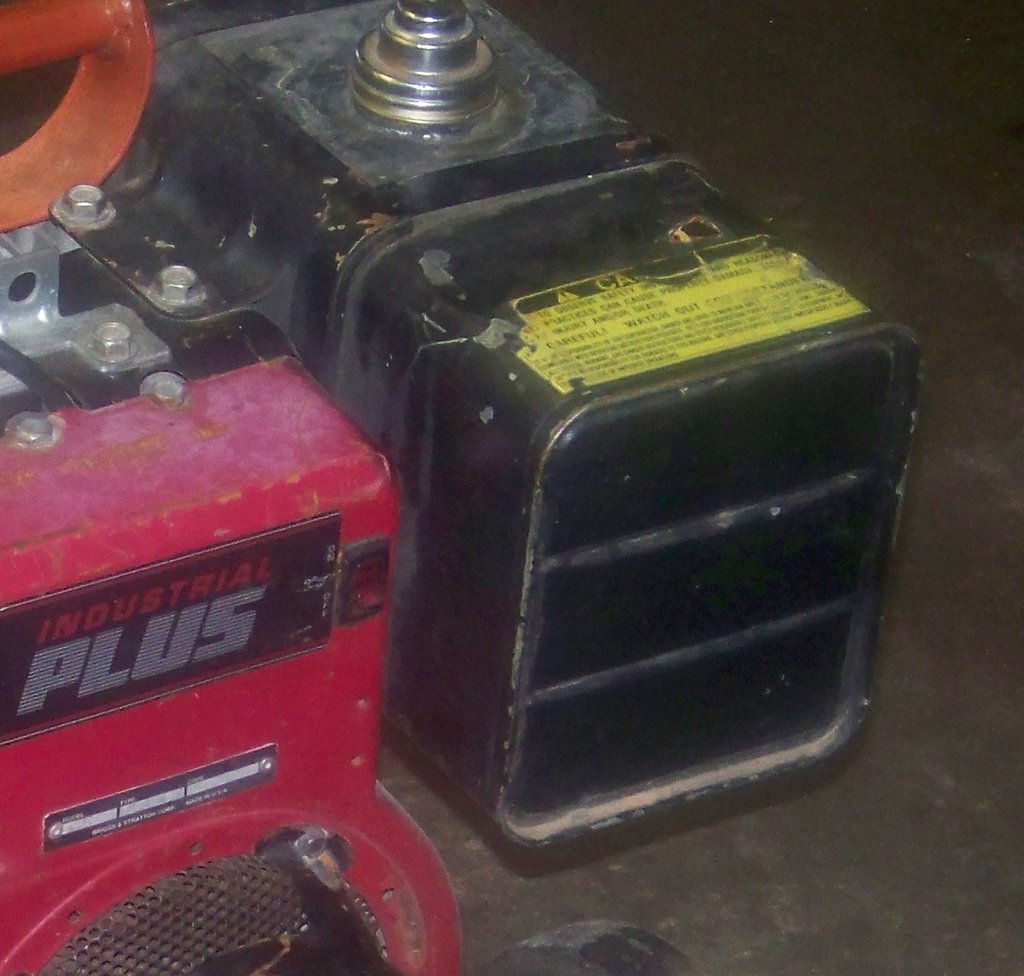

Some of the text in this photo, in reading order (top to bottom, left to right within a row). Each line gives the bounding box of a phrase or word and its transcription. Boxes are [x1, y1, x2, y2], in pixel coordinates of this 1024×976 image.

[673, 301, 699, 315] OUT
[38, 557, 273, 645] INDUSTRIAL
[17, 585, 266, 717] PLUS
